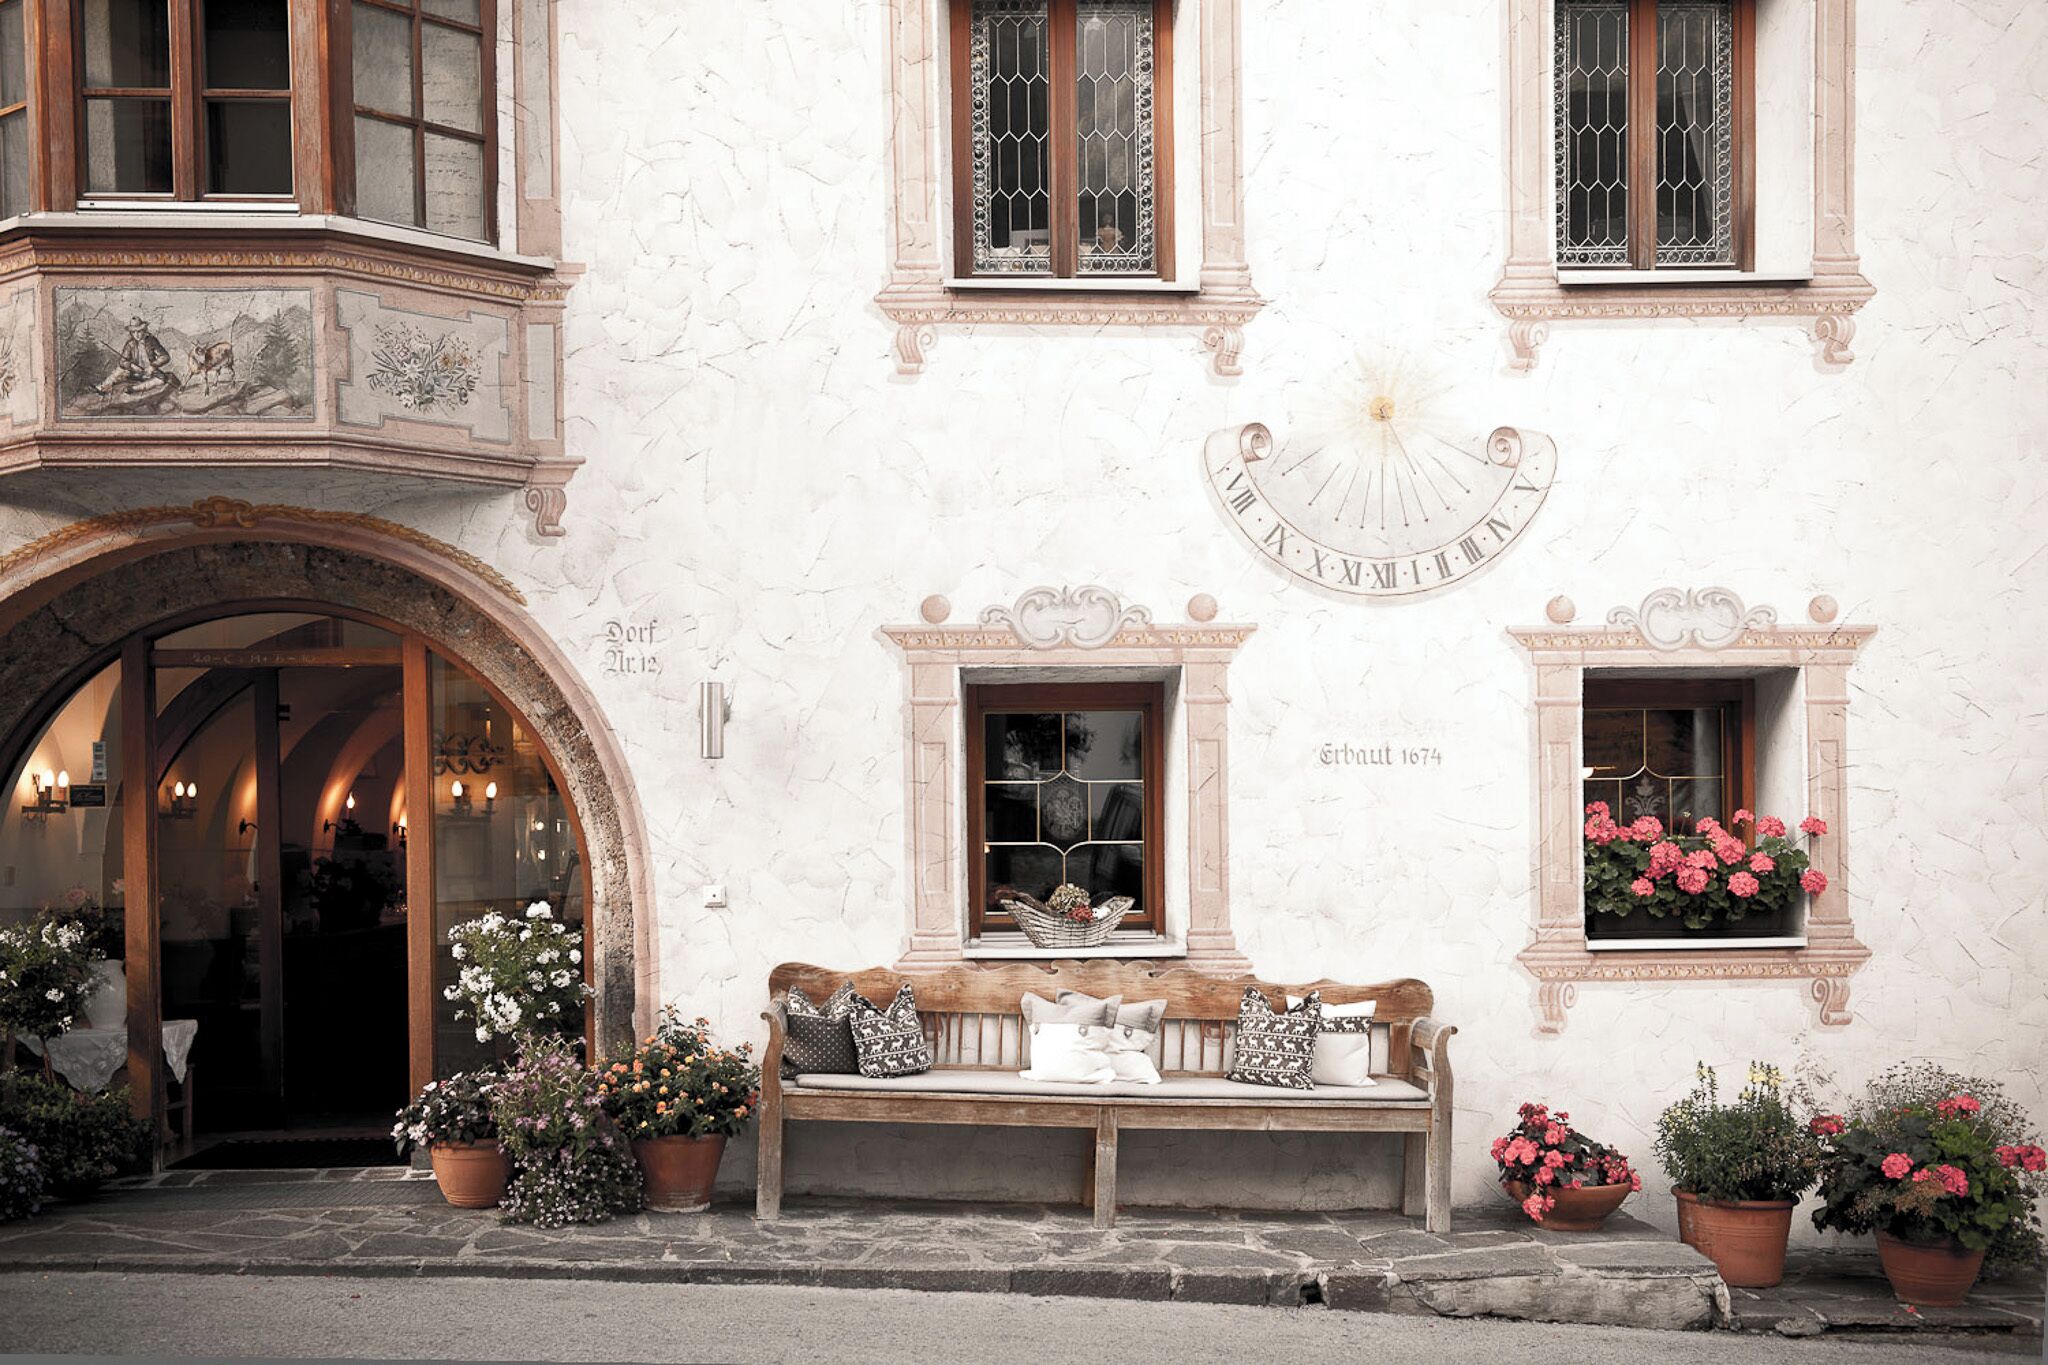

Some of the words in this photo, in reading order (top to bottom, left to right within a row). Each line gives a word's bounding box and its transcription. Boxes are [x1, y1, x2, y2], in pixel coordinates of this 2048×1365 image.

[1225, 471, 1257, 515] VIII
[1263, 521, 1295, 558] IX
[1305, 547, 1330, 578] X
[1337, 558, 1362, 586] XI
[1369, 562, 1397, 589] XII
[1410, 559, 1420, 585] I
[1433, 551, 1455, 580] II
[1458, 535, 1485, 565] III
[1486, 508, 1512, 542] IV
[1513, 473, 1539, 492] V
[606, 619, 658, 644] Dorf
[1319, 743, 1392, 765] Erbaut
[1402, 748, 1441, 765] 1674
